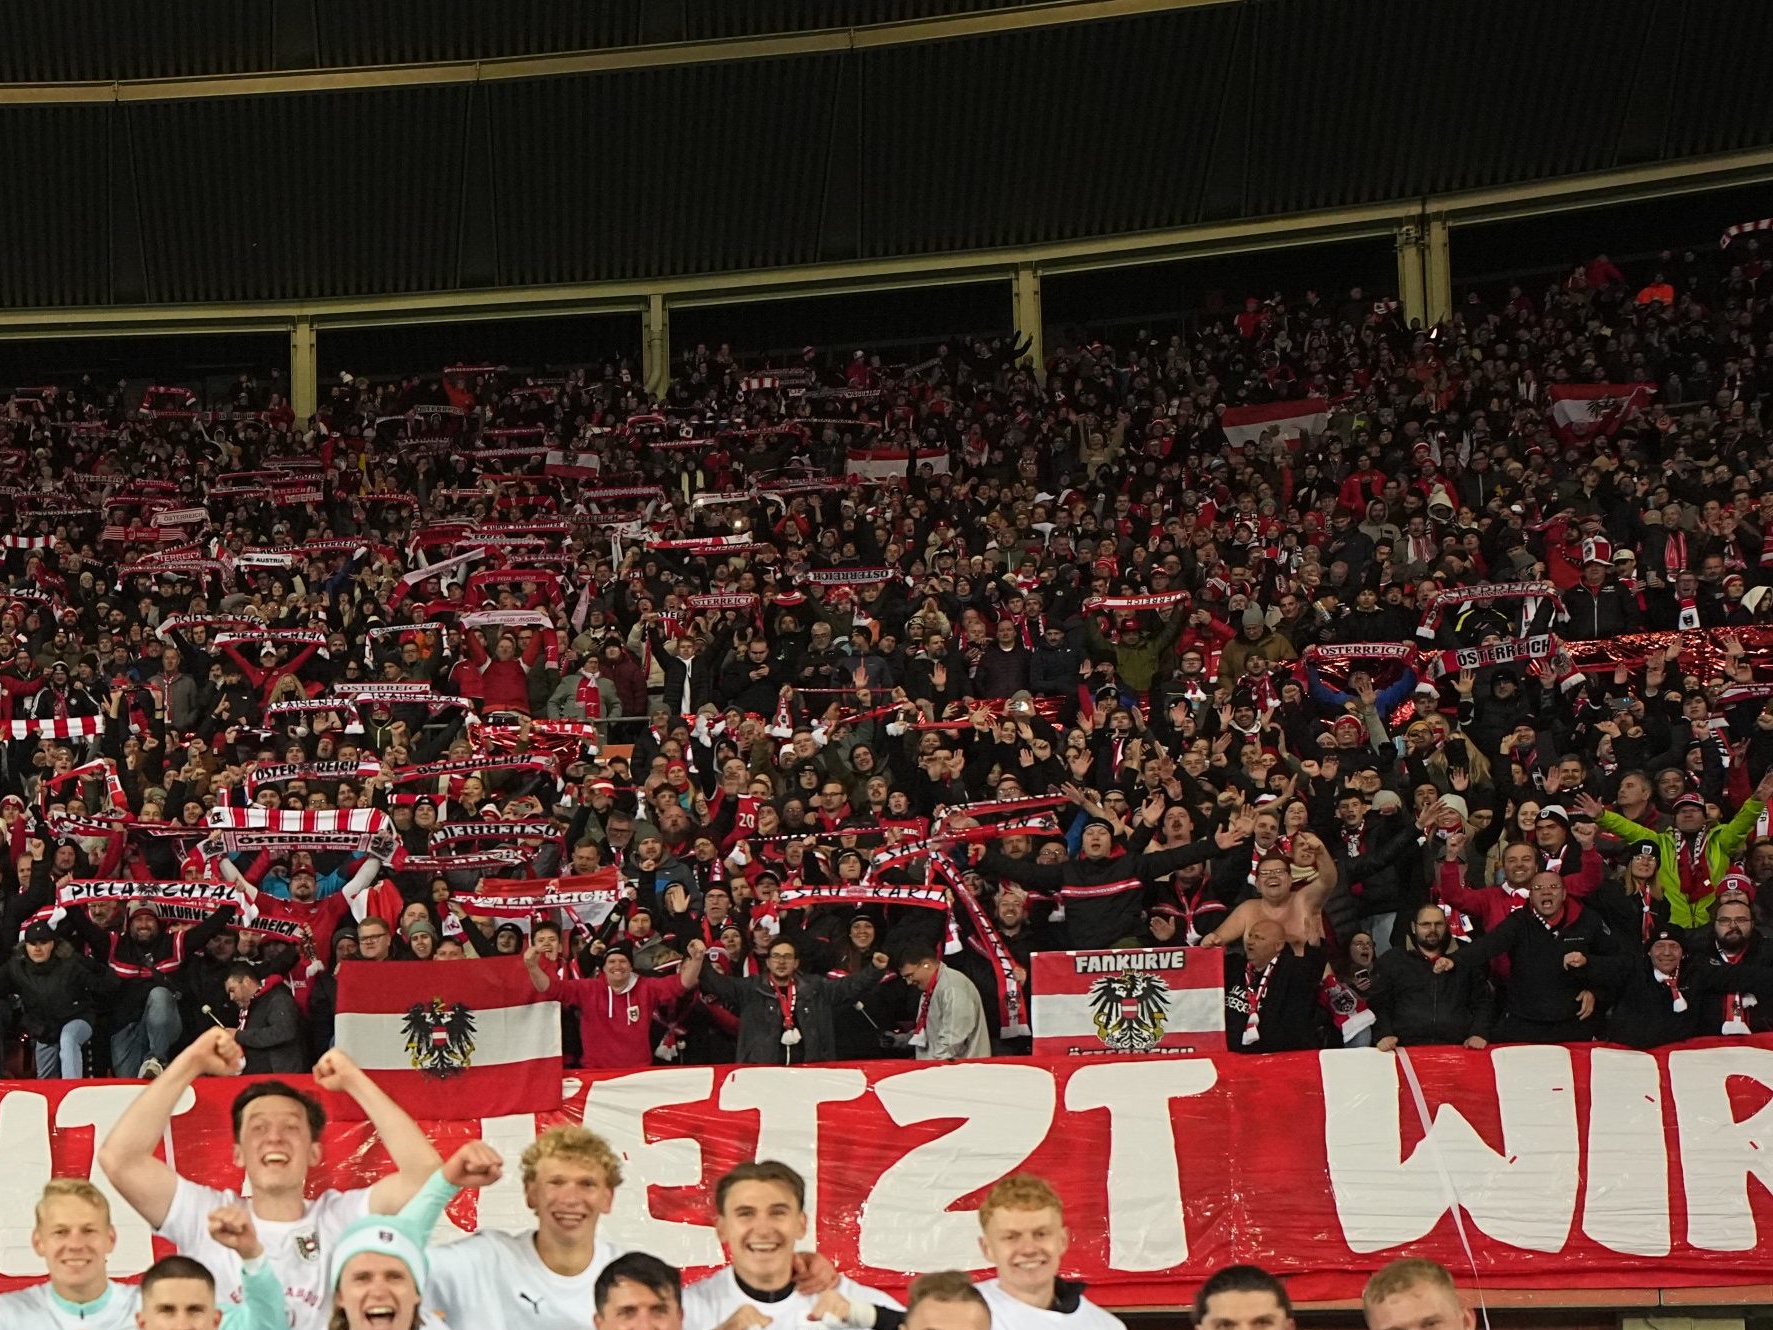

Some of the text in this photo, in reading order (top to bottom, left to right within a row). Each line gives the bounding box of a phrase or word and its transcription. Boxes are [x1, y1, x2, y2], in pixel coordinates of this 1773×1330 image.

[1456, 635, 1550, 668] ÖSTERREICH
[738, 812, 755, 828] 20
[237, 832, 359, 845] ÖSTERREICH
[1075, 950, 1185, 973] FANKURVE
